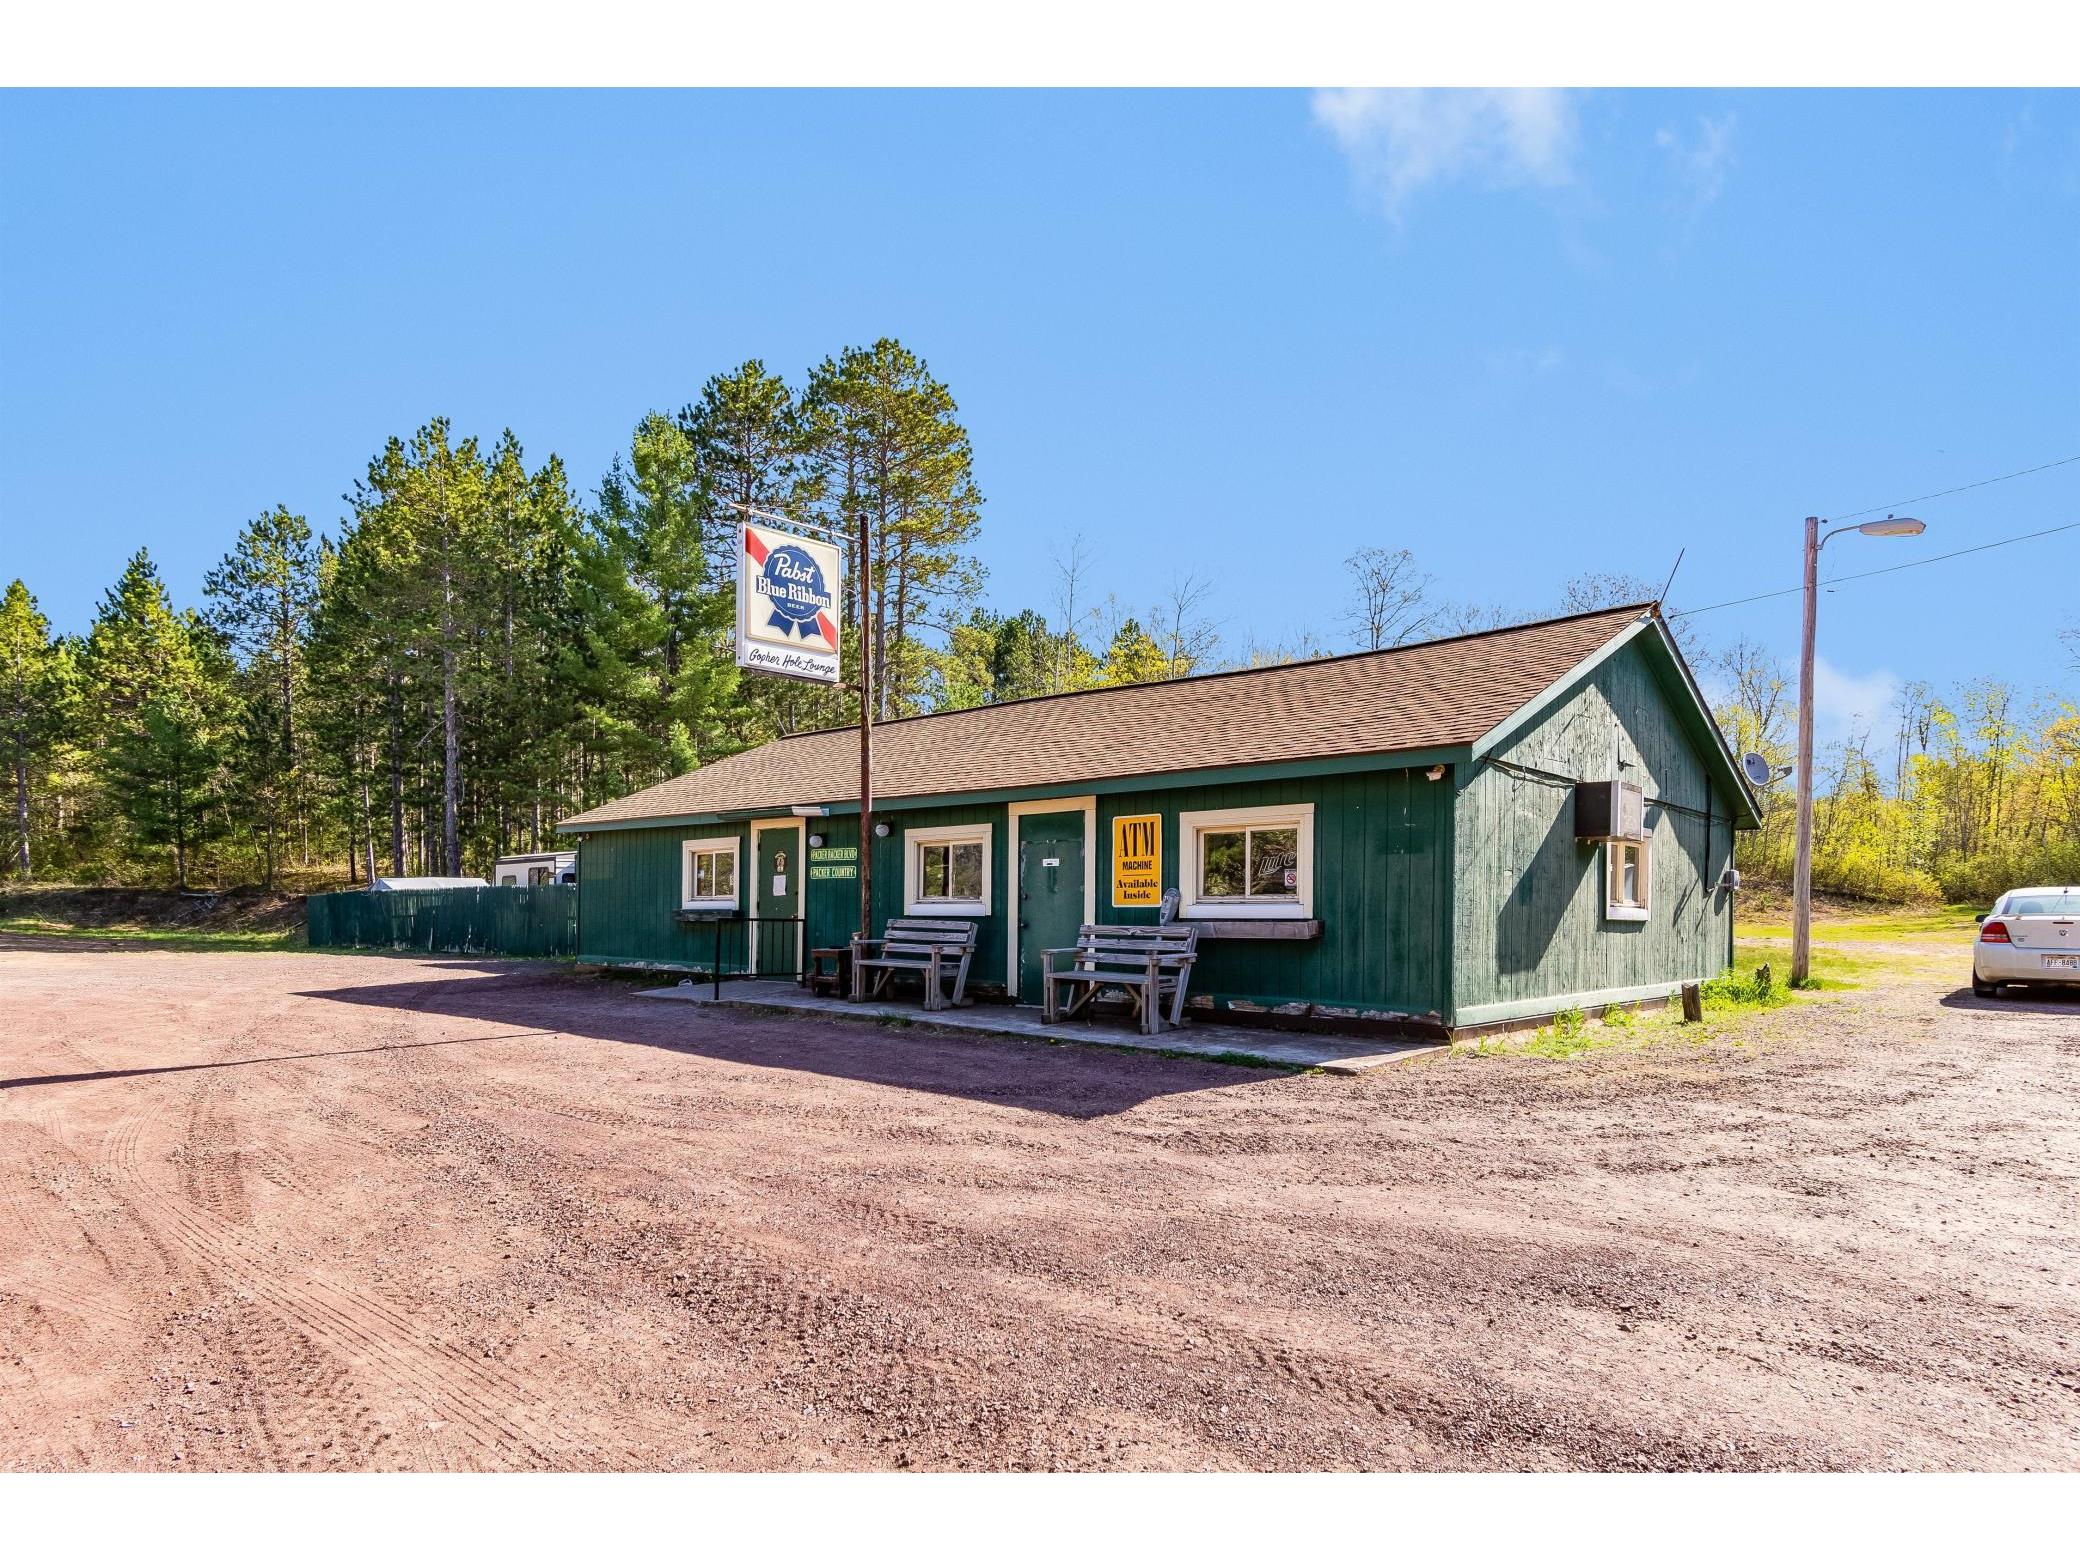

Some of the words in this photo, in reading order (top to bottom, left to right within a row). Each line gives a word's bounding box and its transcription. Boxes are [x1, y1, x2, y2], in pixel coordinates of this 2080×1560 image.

[774, 553, 815, 584] Pabst
[758, 577, 786, 598] Blue
[788, 583, 831, 608] Ribbon
[787, 602, 805, 610] BEER
[749, 648, 780, 665] Gopher
[783, 654, 802, 669] Hole
[801, 660, 836, 677] Lounge
[1119, 822, 1155, 857] ATM
[1122, 860, 1152, 870] MACHINE
[812, 868, 831, 877] PACKER
[832, 867, 854, 877] COUNTRY
[1116, 879, 1158, 889] Available
[1123, 890, 1151, 899] Inside
